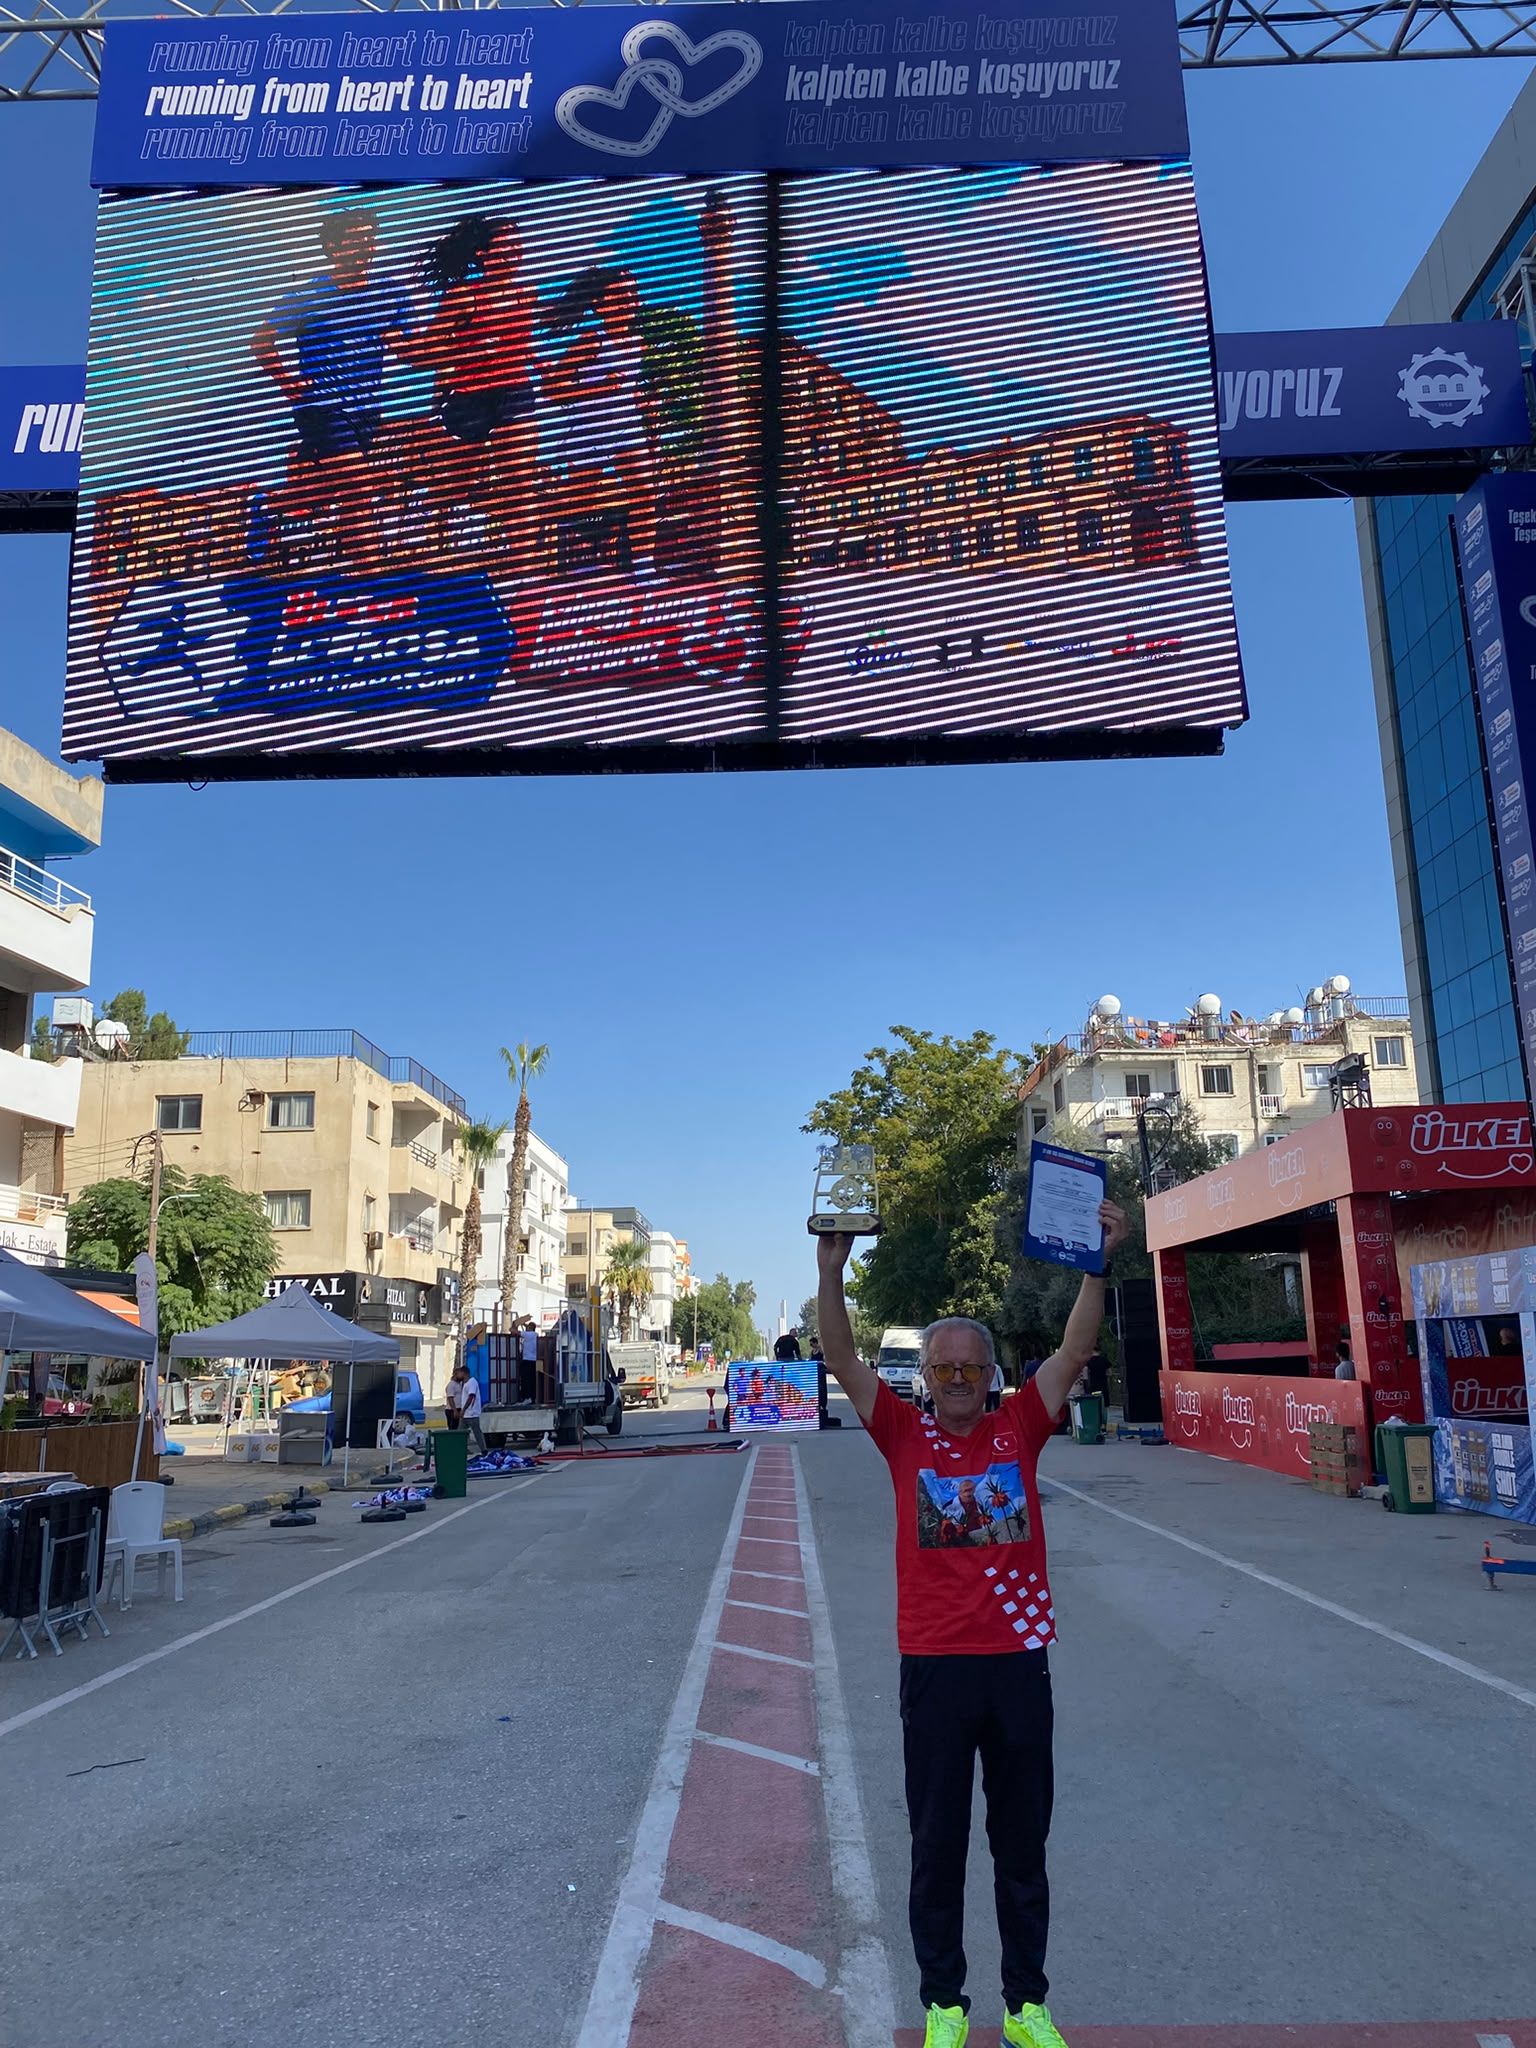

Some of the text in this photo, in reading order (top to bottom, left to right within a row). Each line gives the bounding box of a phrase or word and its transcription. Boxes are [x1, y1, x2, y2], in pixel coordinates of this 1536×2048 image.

[149, 27, 534, 76] running from heart to heart
[145, 72, 533, 121] running from heart to heart
[785, 59, 1120, 106] kalpten kalbe koşuyoruz
[141, 116, 533, 164] running from heart to heart
[1217, 367, 1343, 431] yoruz
[0, 1230, 17, 1248] lak
[28, 1234, 58, 1252] Estate
[1358, 1232, 1392, 1242] ÜLKER
[386, 1288, 406, 1307] HIZAL
[1366, 1311, 1401, 1323] ÜLKER
[1176, 1382, 1202, 1416] ÜLKER
[1223, 1386, 1255, 1425] ÜLKER
[1375, 1390, 1410, 1401] ÜLKER
